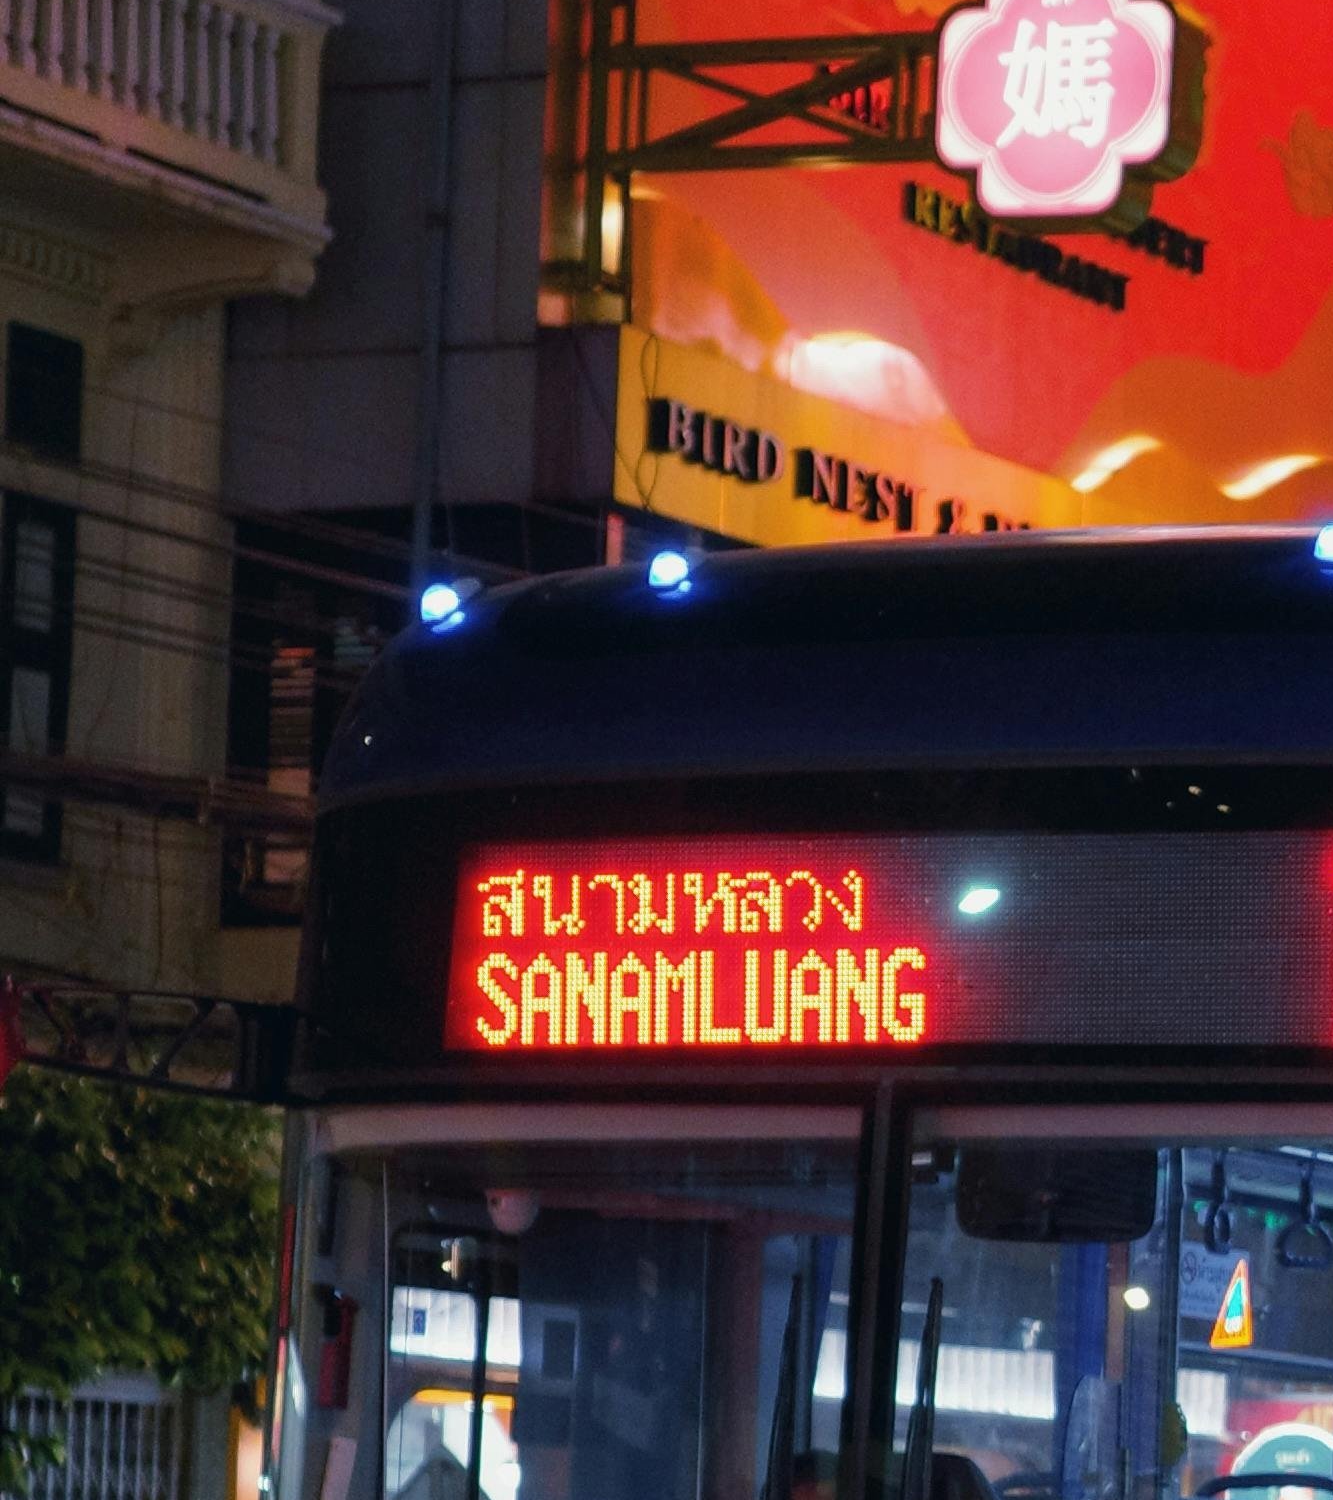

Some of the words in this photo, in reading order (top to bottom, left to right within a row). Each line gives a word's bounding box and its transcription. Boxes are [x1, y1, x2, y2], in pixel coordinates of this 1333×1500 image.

[996, 19, 1118, 148] 媽
[650, 399, 785, 482] BIRD
[797, 447, 924, 531] NEST
[477, 869, 864, 936] สนามหลวง
[476, 948, 924, 1045] SANAMLUANG
